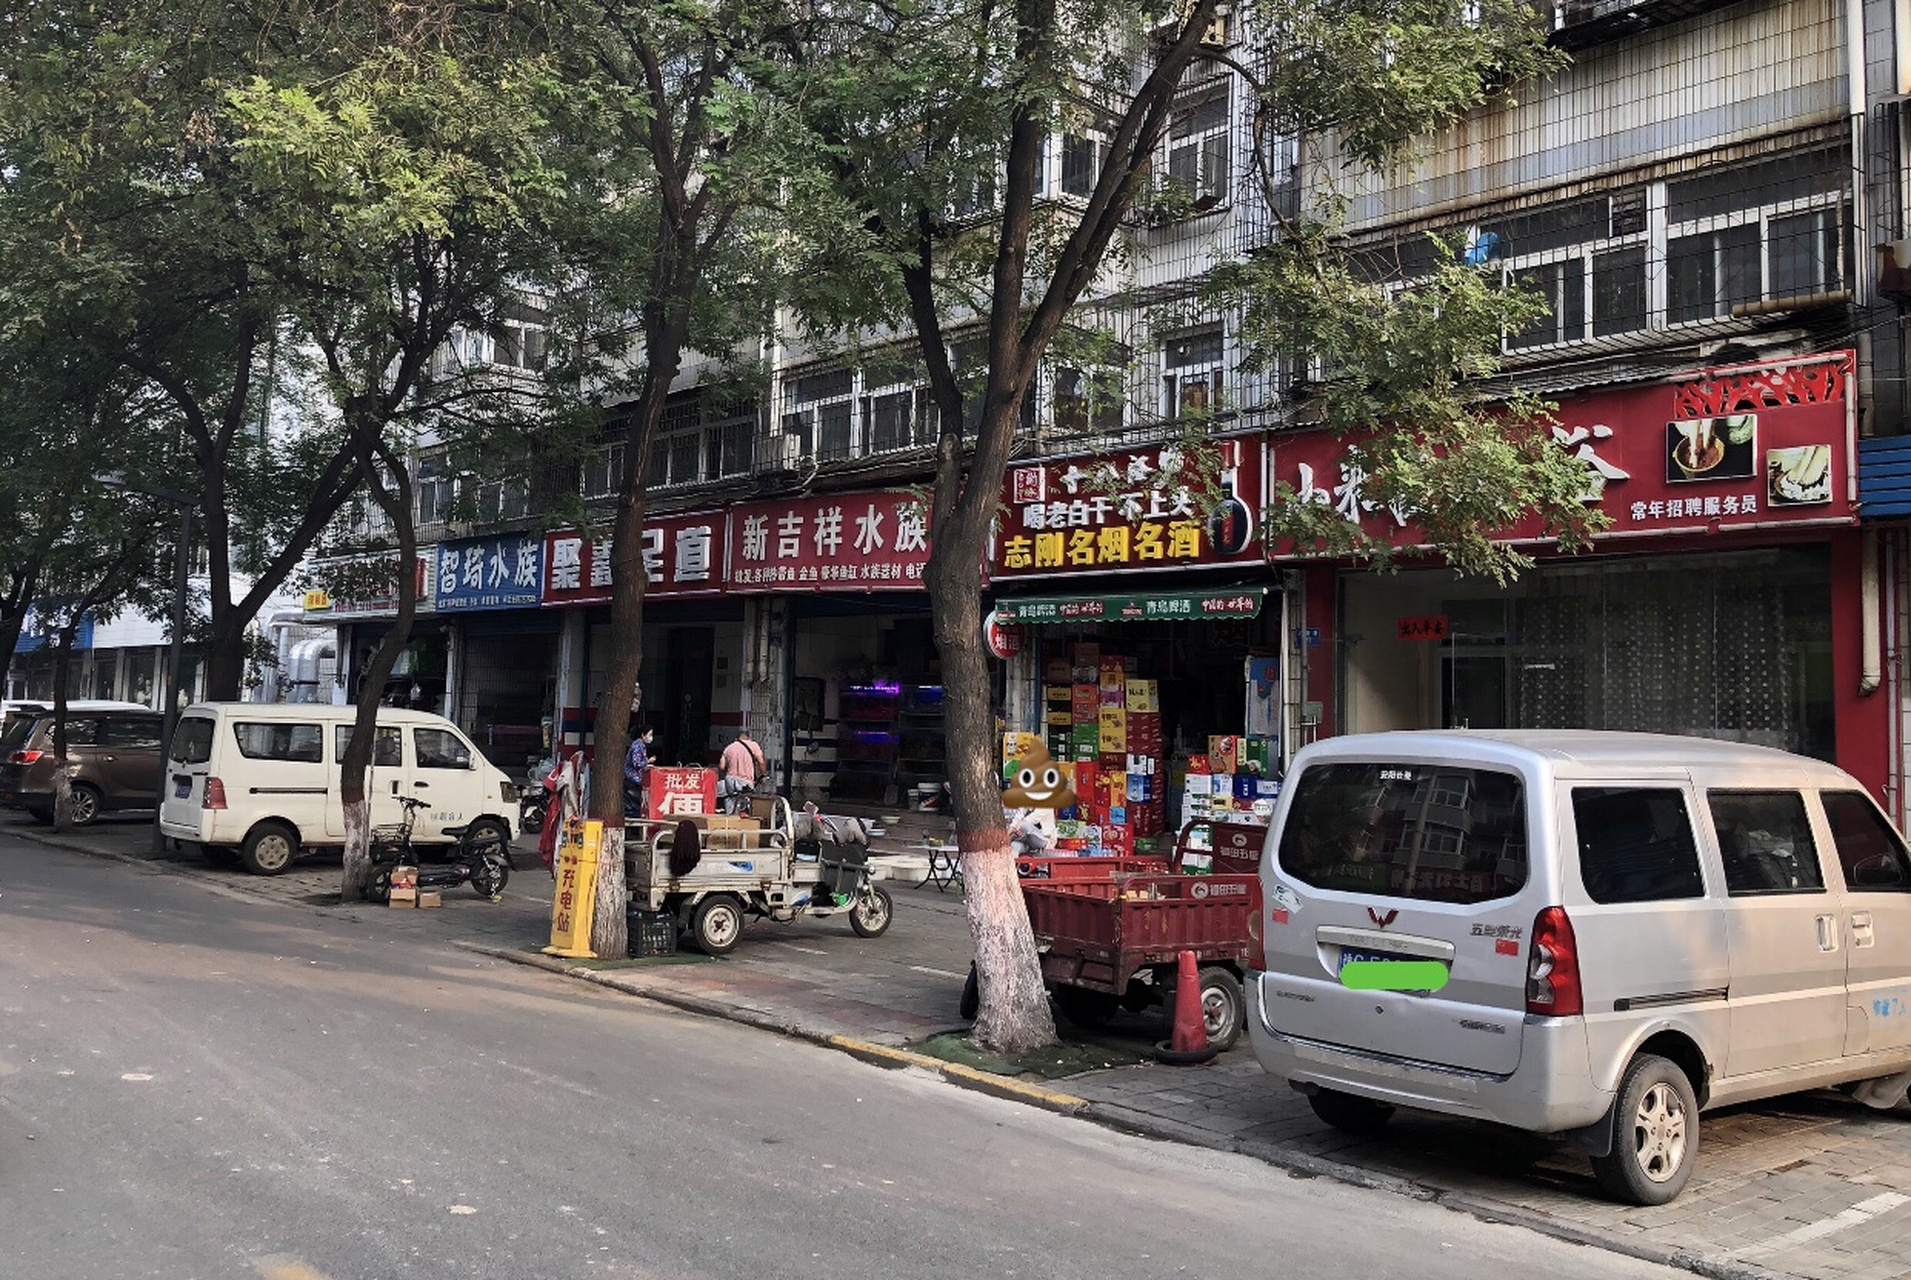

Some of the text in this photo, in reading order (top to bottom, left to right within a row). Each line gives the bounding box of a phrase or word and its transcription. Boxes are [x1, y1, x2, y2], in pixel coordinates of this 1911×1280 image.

[1630, 495, 1758, 521] 常年招聘服务员
[742, 502, 927, 561] 新吉祥水族
[1004, 520, 1200, 568] 志刚名烟名酒
[798, 565, 818, 581] 金鱼
[1146, 599, 1192, 615] 青岛啤酒
[665, 773, 701, 790] 批发
[557, 868, 575, 932] 充电站
